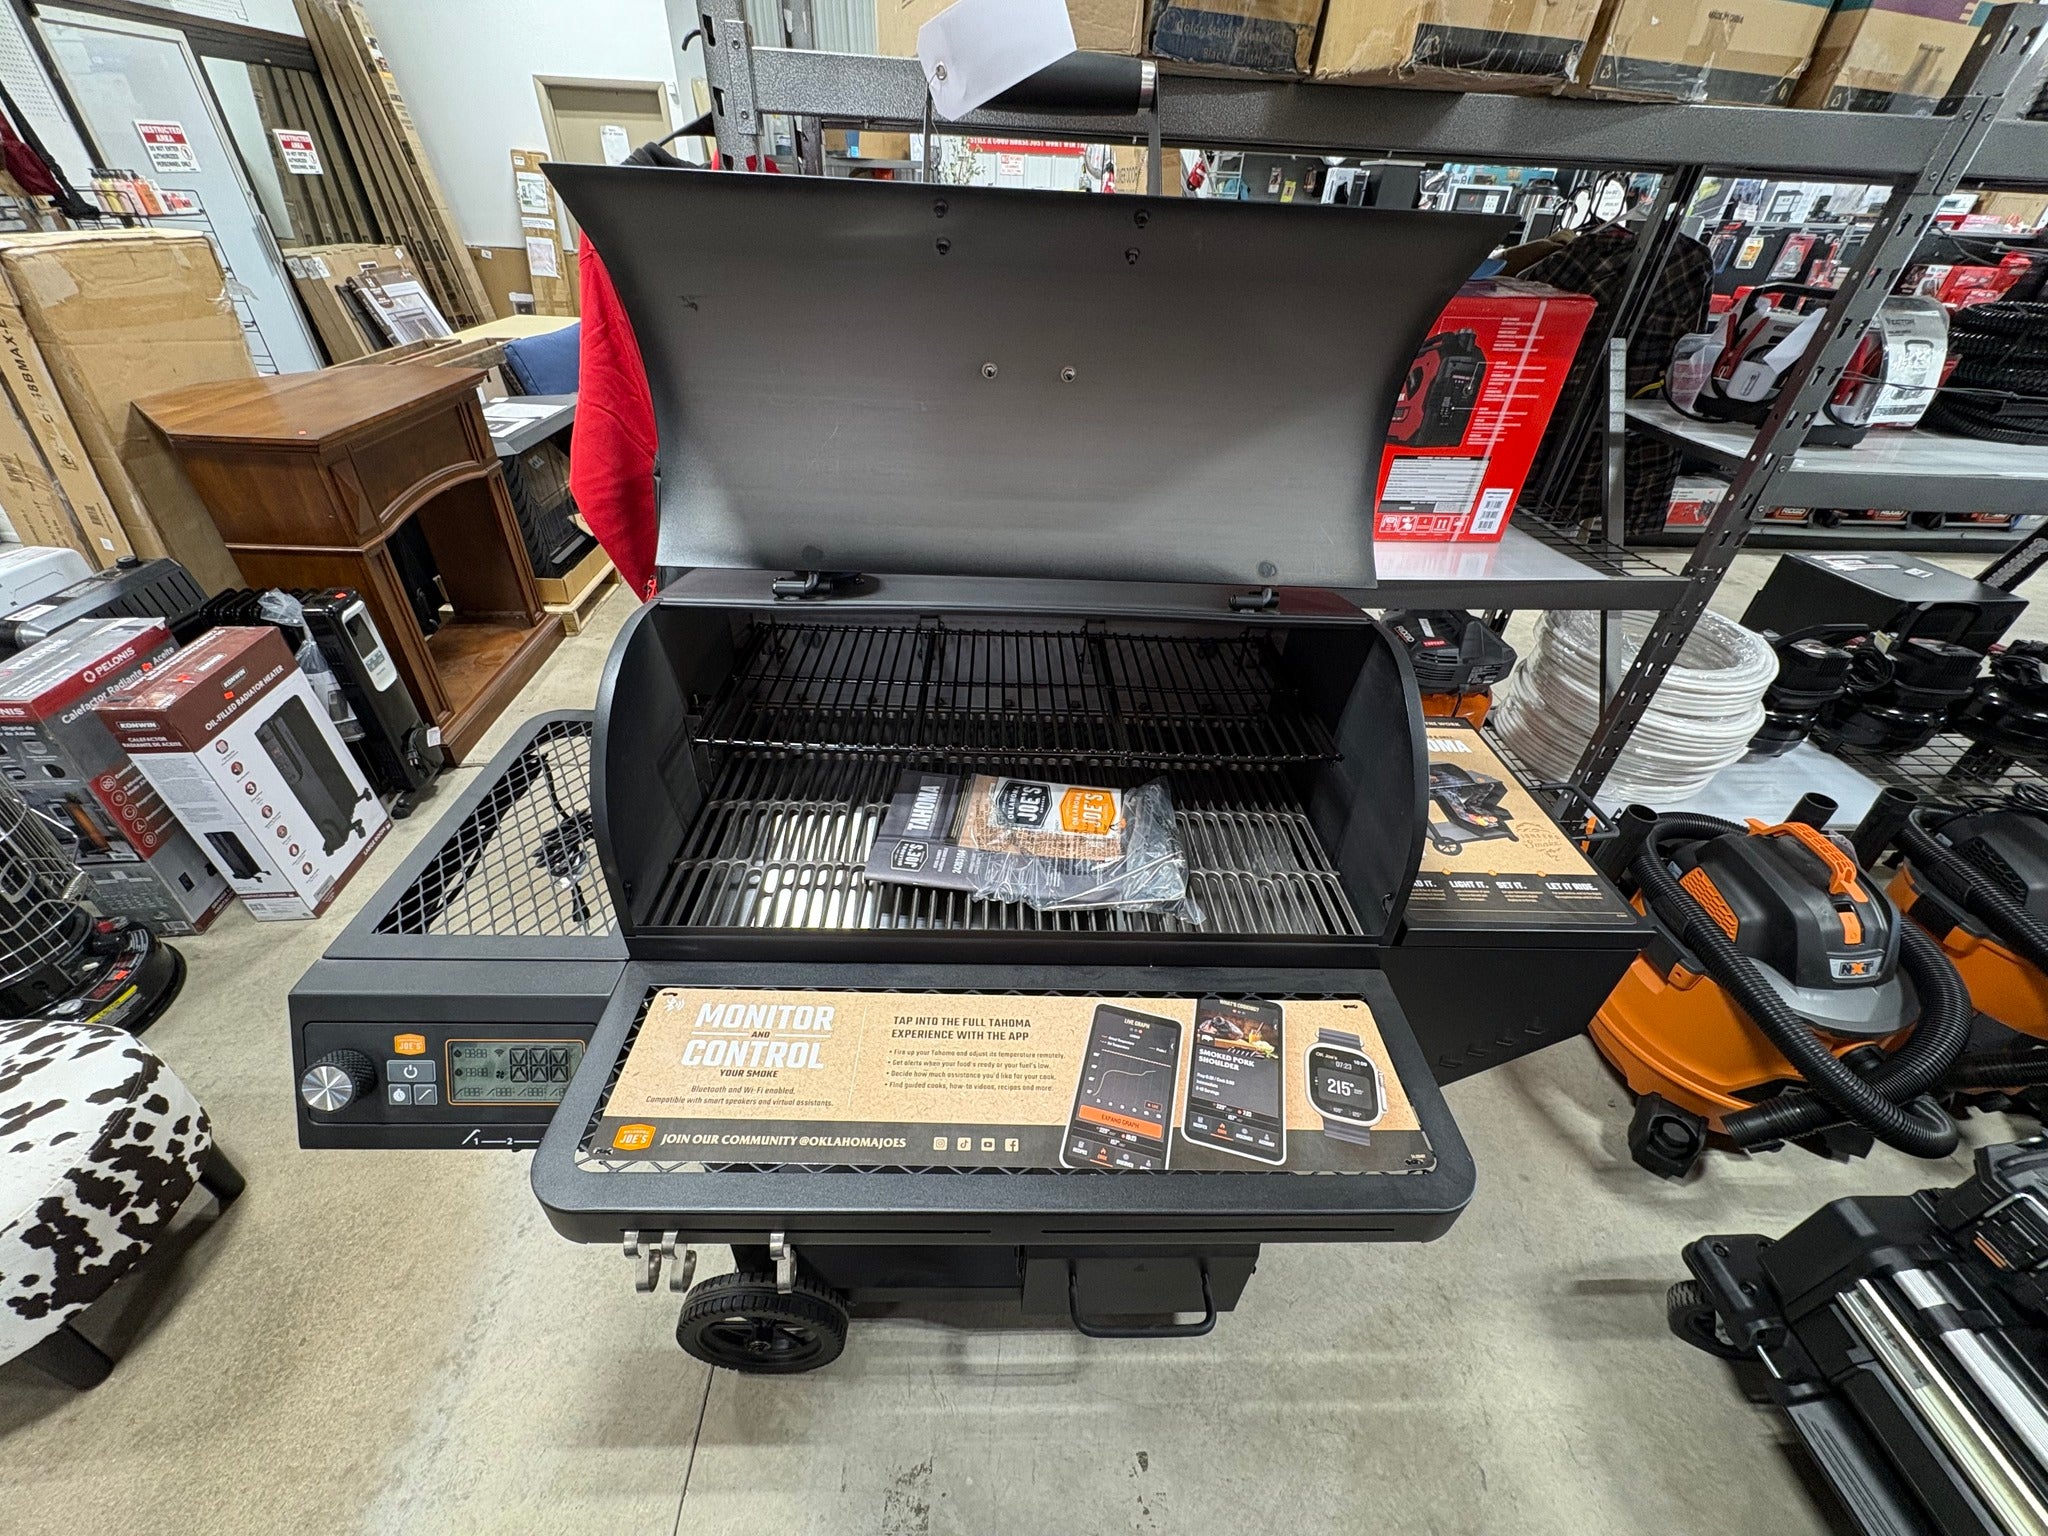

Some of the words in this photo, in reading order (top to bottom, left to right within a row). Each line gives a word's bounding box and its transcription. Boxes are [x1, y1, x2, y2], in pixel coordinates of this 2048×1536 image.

[139, 125, 182, 135] RESTRICTED
[155, 134, 176, 143] AREA
[279, 134, 310, 142] RESTRICTED
[291, 141, 305, 149] AREA
[95, 646, 136, 676] PELONIS
[61, 692, 107, 724] Calefactor
[107, 668, 144, 696] Radiante
[152, 646, 175, 665] Aceite
[222, 668, 246, 689] KONWIN
[204, 700, 238, 731] OIL-FILLED
[236, 681, 265, 708] RADIATOR
[263, 664, 285, 686] HEATER
[1427, 739, 1473, 753] OMA
[906, 785, 941, 831] TAHOMA
[1007, 785, 1021, 820] OKLAHOMA
[1017, 786, 1043, 822] JOE'S
[1071, 792, 1083, 826] OKLAHOMA
[1082, 792, 1104, 828] JOE'S
[903, 843, 924, 868] JOE'S
[1449, 880, 1477, 889] LIGHT
[1477, 881, 1489, 889] IT.
[1495, 880, 1512, 889] SET
[1513, 881, 1527, 890] IT.
[1545, 882, 1563, 890] LET
[1562, 882, 1573, 890] IT
[1572, 883, 1598, 891] RIDE.
[1838, 960, 1875, 977] NXT
[694, 1002, 836, 1031] MONITOR
[893, 1016, 913, 1026] TAP
[915, 1016, 938, 1026] INTO
[941, 1017, 960, 1026] THE
[962, 1017, 985, 1027] FULL
[988, 1018, 1031, 1028] TAHOMA
[1134, 1020, 1151, 1029] GRAPH
[891, 1029, 954, 1040] EXPERIENCE
[956, 1030, 984, 1040] WITH
[987, 1031, 1006, 1040] THE
[1008, 1031, 1029, 1041] APP
[681, 1039, 824, 1069] CONTROL
[969, 1050, 988, 1058] adjust
[998, 1051, 1036, 1059] temperature
[1036, 1052, 1066, 1060] remotely.
[1198, 1048, 1233, 1062] SMOKED
[1232, 1055, 1255, 1068] PORK
[977, 1061, 995, 1069] ready
[1198, 1056, 1240, 1071] SHOULDER
[1335, 1061, 1353, 1070] 07:23
[720, 1069, 744, 1078] YOUR
[746, 1069, 779, 1078] SMOKE
[691, 1085, 727, 1095] Bluetooth
[727, 1086, 742, 1094] and
[743, 1086, 764, 1094] Wi-Fi
[764, 1086, 796, 1095] enabled.
[927, 1082, 948, 1090] cooks,
[974, 1083, 996, 1091] videos,
[997, 1084, 1021, 1092] recipes
[1327, 1078, 1355, 1097] 215°
[645, 1095, 686, 1105] Compatible
[686, 1096, 702, 1104] with
[703, 1097, 724, 1105] smart
[725, 1097, 757, 1106] speakers
[758, 1098, 772, 1106] and
[773, 1098, 795, 1106] virtual
[796, 1099, 834, 1107] assistants.
[1101, 1114, 1122, 1126] EXPAND
[1121, 1117, 1140, 1129] GRAPH
[473, 1137, 479, 1145] 1
[506, 1137, 513, 1145] 2
[619, 1133, 649, 1144] JOE'S
[660, 1133, 691, 1146] JOIN
[692, 1134, 719, 1145] OUR
[721, 1134, 799, 1146] COMMUNITY
[799, 1135, 907, 1149] @OKLAHOMAJOES
